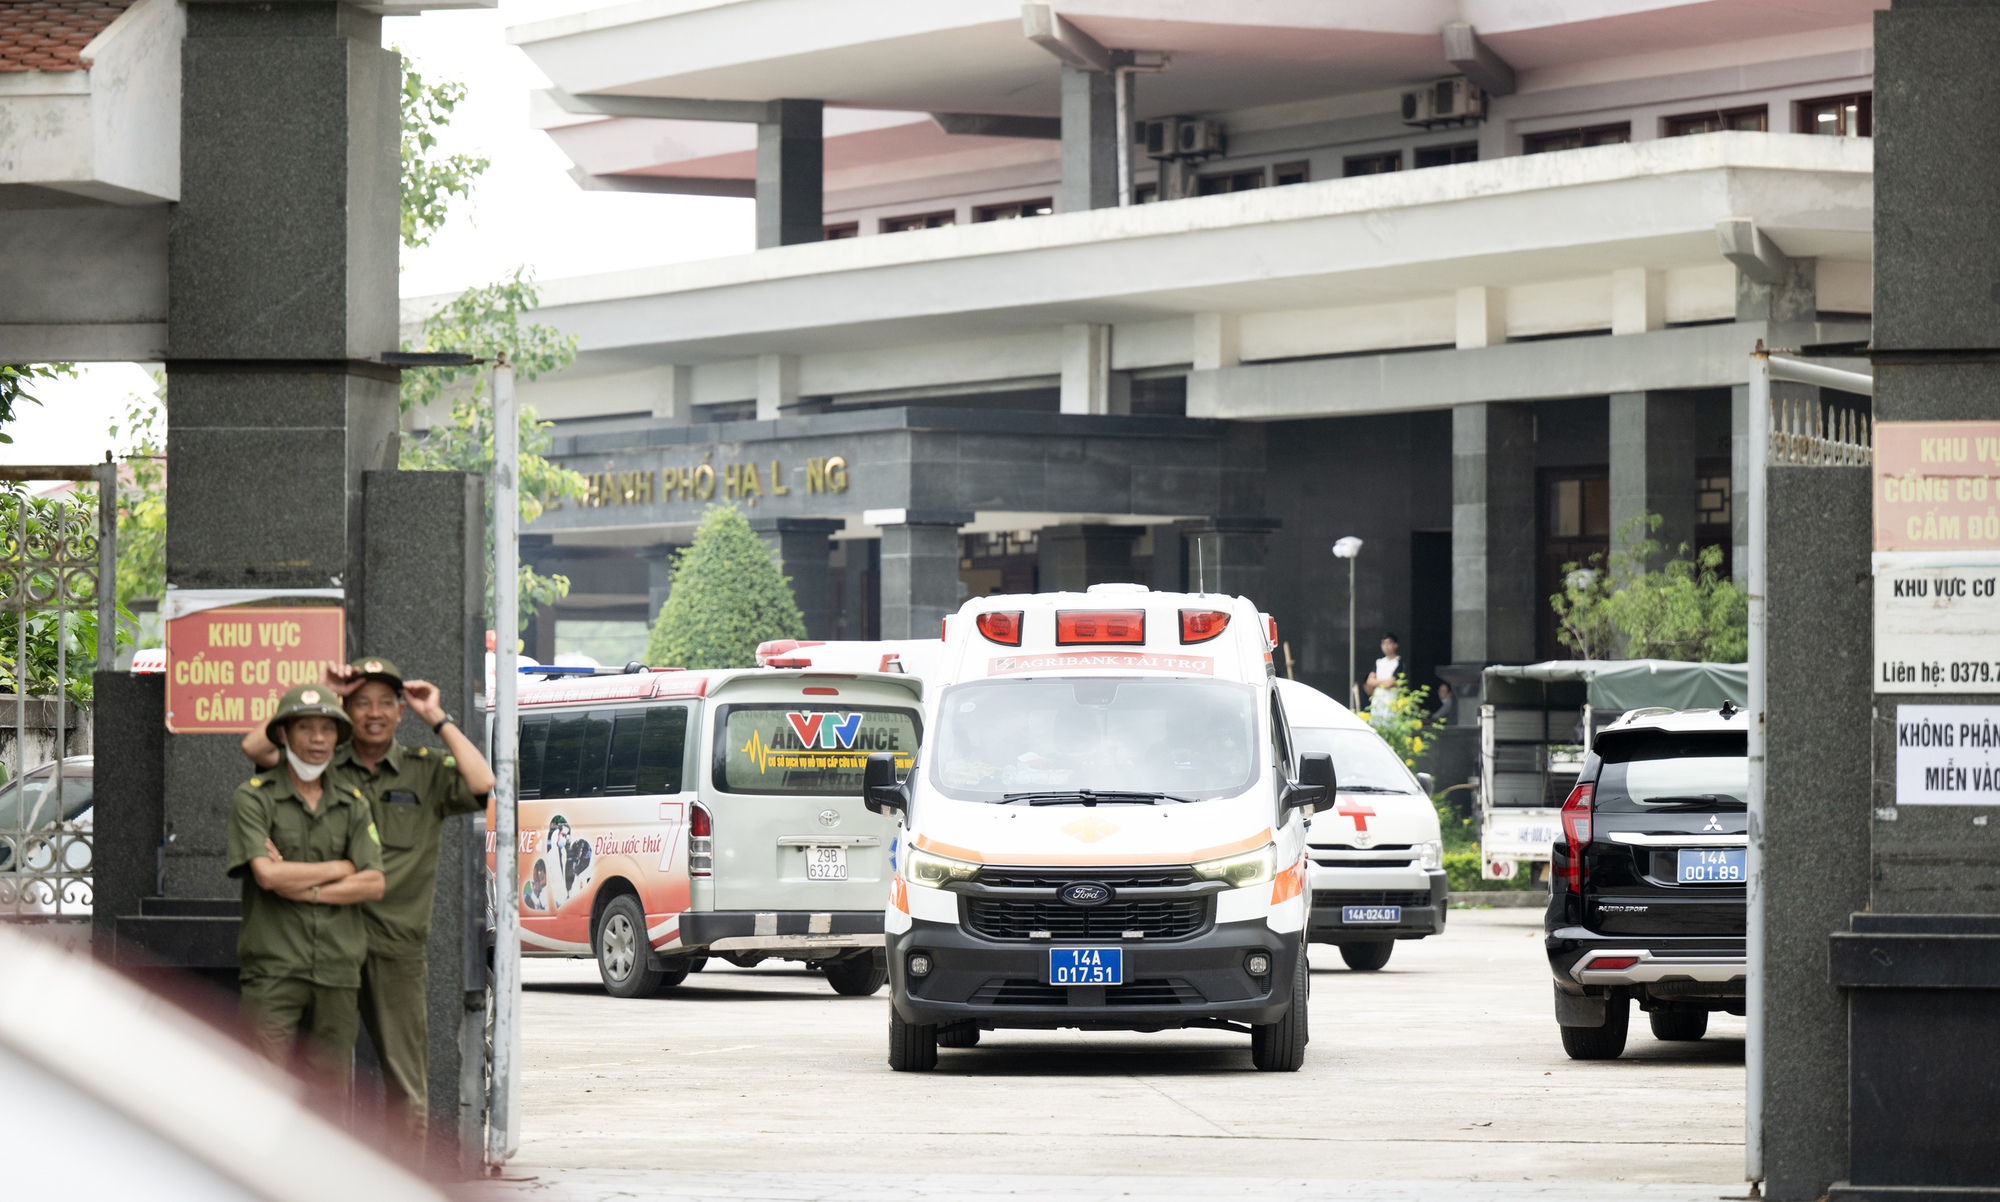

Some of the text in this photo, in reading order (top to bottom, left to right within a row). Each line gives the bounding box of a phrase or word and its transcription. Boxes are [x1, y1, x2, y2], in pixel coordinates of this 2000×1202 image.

[1921, 437, 1967, 463] KHU
[576, 461, 654, 507] HÀNH
[724, 462, 764, 507] HẠ
[1884, 467, 1949, 503] CỔNG
[1956, 474, 1989, 502] CƠ
[1906, 505, 2000, 541] CẤM ĐỖ
[1893, 577, 1996, 602] KHU VỰC CƠ
[208, 620, 301, 652] KHU VỰC
[175, 651, 234, 685] CỔNG
[241, 658, 271, 685] CƠ
[1020, 654, 1207, 671] AGRIBANK TÀI TRỢ
[1882, 660, 1916, 683] Liên
[1921, 661, 1945, 687] hệ:
[195, 689, 245, 721] CẤM
[785, 712, 864, 750] VTV
[1899, 717, 1954, 747] KHÔNG
[1925, 757, 1967, 791] MIỄN
[518, 829, 536, 854] XE
[594, 832, 619, 856] Điều
[641, 833, 662, 854] thứ
[816, 849, 838, 863] 29B
[1700, 850, 1728, 865] 14A
[809, 863, 847, 878] 632.20
[1685, 865, 1739, 881] 001.89
[1072, 887, 1101, 900] Ford
[1348, 909, 1396, 920] 14A-024.01
[1072, 949, 1102, 966] 14A
[1057, 966, 1113, 983] 017.51
